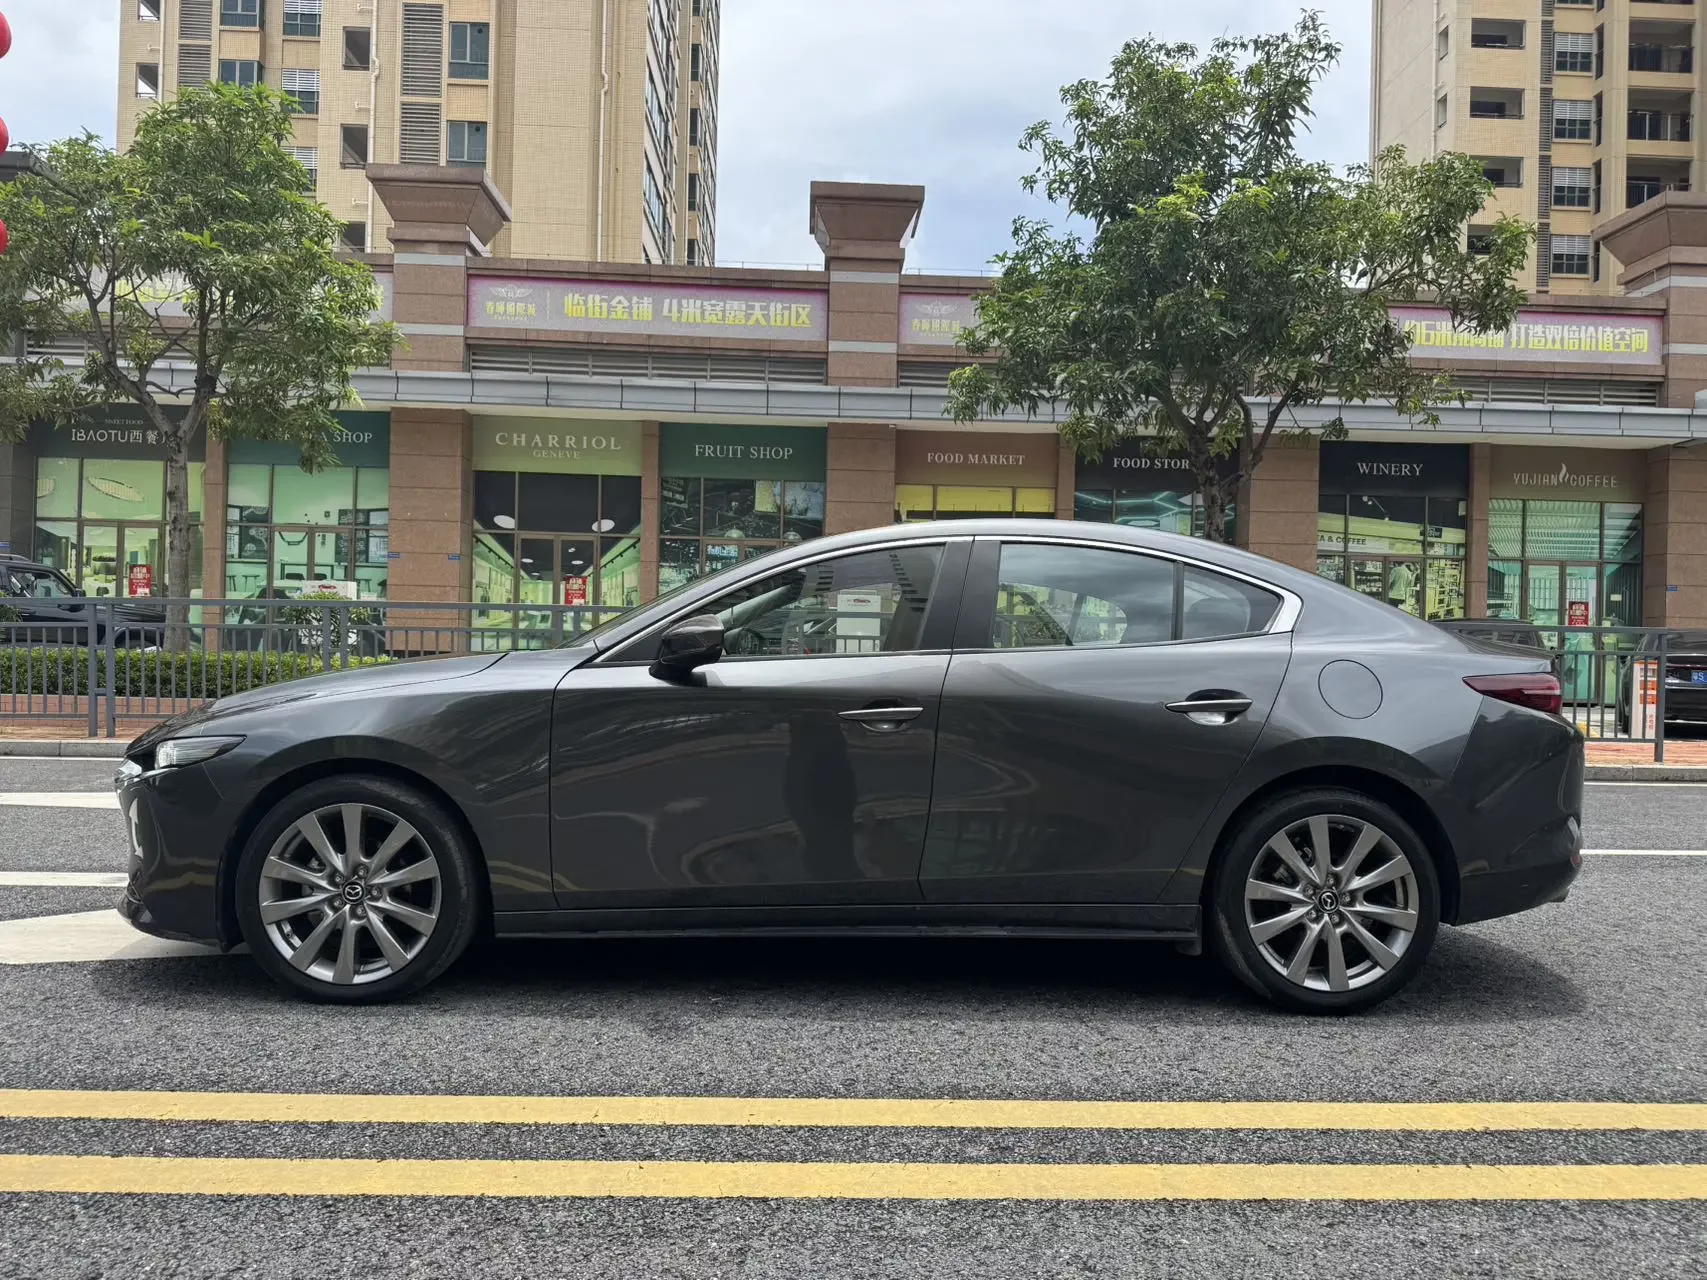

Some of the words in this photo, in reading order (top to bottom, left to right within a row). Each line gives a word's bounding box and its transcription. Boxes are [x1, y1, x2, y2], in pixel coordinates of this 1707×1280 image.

[564, 293, 653, 321] 临街金铺
[662, 299, 812, 328] 4米宽露天街区
[1511, 324, 1649, 353] 打造双倍价值空间
[332, 431, 373, 443] SHOP
[495, 432, 621, 450] CHARRIOL
[533, 449, 581, 460] GENEVE
[695, 444, 744, 458] FRUIT
[749, 446, 793, 460] SHOP
[927, 452, 964, 464] FOOD
[968, 453, 1026, 465] MARKET
[1113, 457, 1151, 469] FOOD
[1154, 458, 1191, 470] STOR
[1356, 461, 1424, 477] WINERY
[1513, 472, 1558, 486] YUJIAN
[1570, 474, 1618, 488] COFFEE
